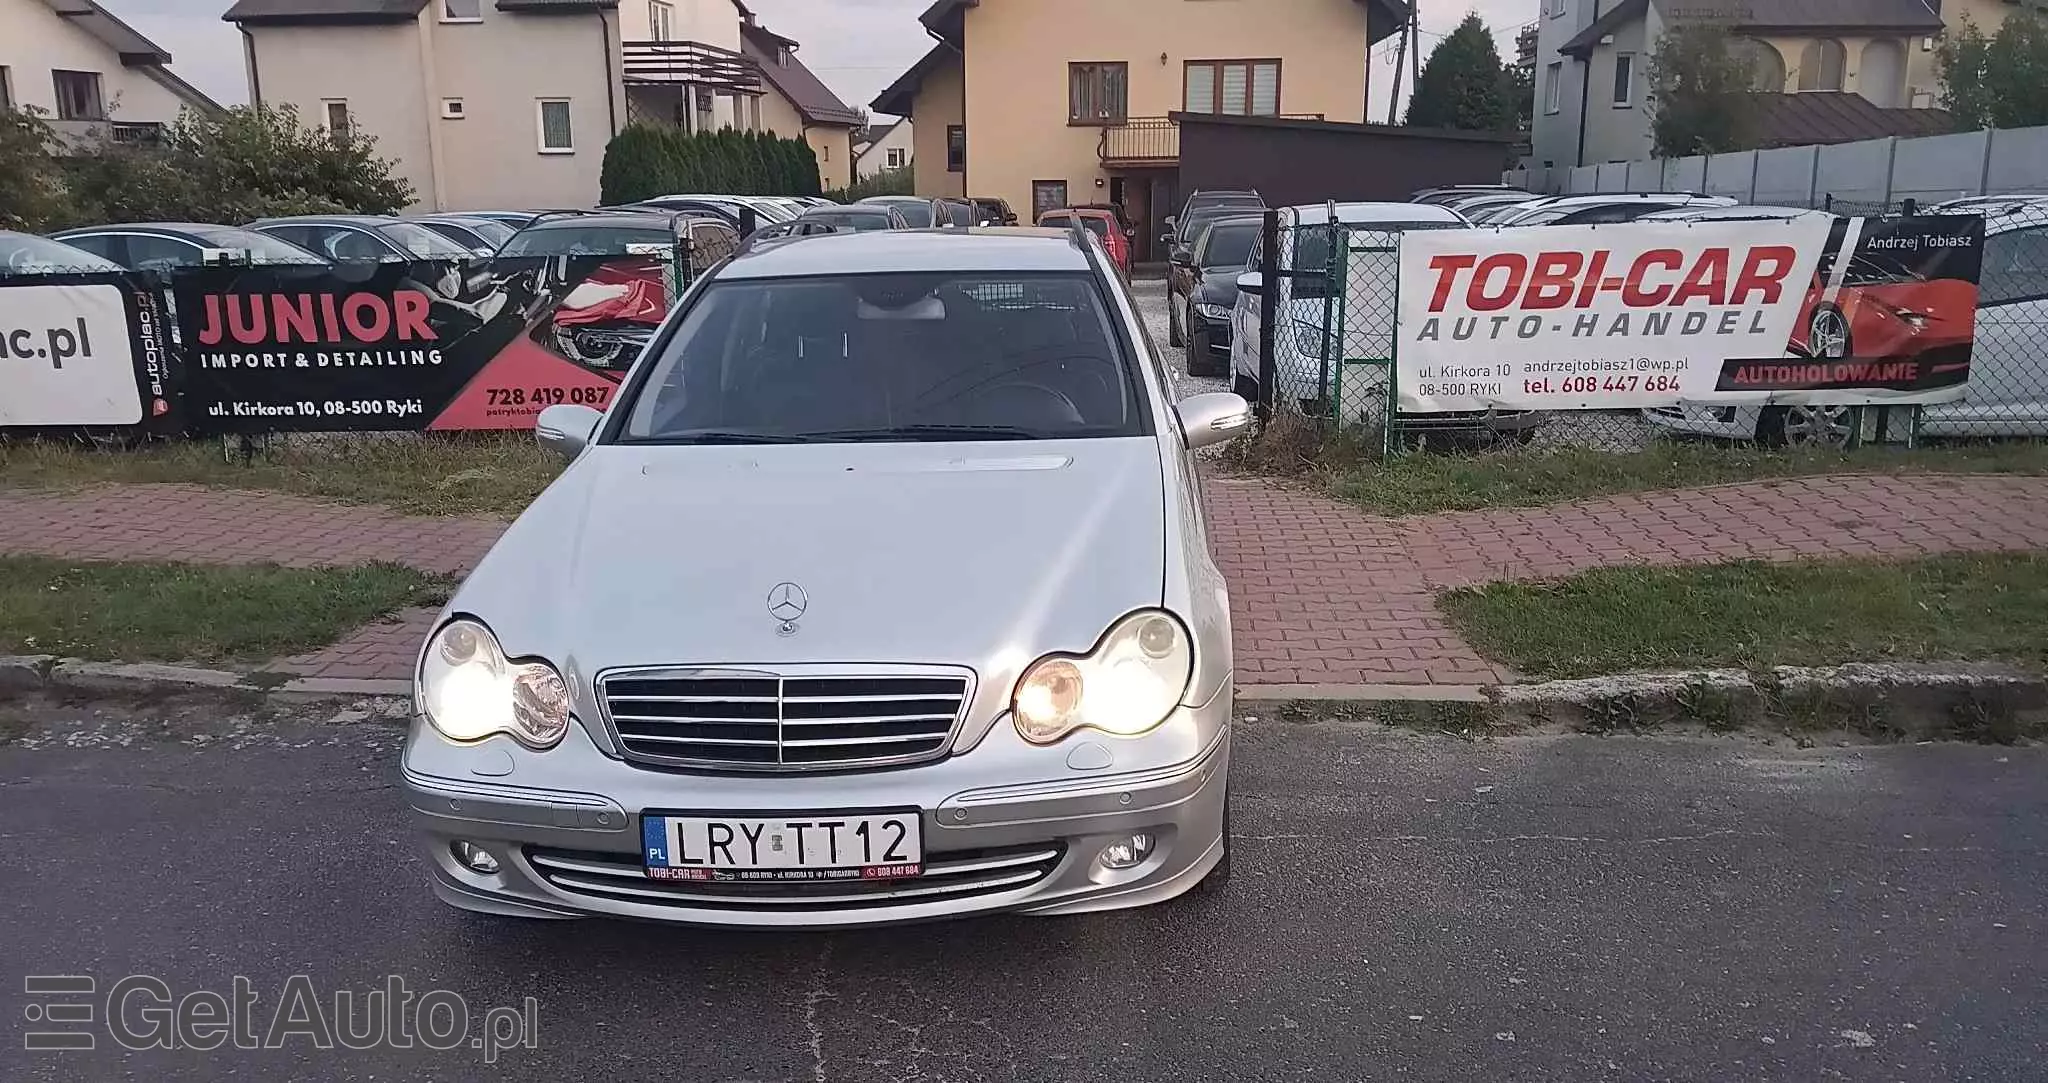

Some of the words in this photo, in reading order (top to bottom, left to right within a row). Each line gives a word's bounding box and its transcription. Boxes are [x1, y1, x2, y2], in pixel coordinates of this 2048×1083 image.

[1867, 235, 1918, 250] Andrzej
[1922, 234, 1972, 247] Tobiasz
[1428, 245, 1797, 312] TOBI-CAR
[199, 290, 440, 345] JUNIOR
[1416, 310, 1767, 341] AUTO-HANDEL
[134, 291, 163, 396] autoplac.pl
[200, 353, 287, 368] IMPORT
[295, 353, 310, 367] &
[317, 350, 443, 366] DETAILING
[1523, 357, 1689, 374] andrzejtobiasz1@wp.pl
[1419, 364, 1436, 378] ul.
[1441, 364, 1490, 378] Kirkora
[1497, 364, 1511, 377] 10
[1734, 363, 1919, 384] AUTOHOLOWANIE
[1419, 383, 1465, 396] 08-500
[1471, 383, 1501, 395] RYKI
[1523, 377, 1555, 394] tel.
[1562, 376, 1597, 393] 608
[1602, 375, 1638, 392] 447
[1645, 375, 1680, 392] 684
[486, 388, 525, 406] 728
[531, 387, 564, 404] 419
[571, 386, 609, 403] 087
[209, 401, 229, 416] ul.
[234, 401, 294, 416] Kirkora
[297, 401, 320, 418] 10,
[324, 400, 383, 415] 08-500
[387, 399, 423, 417] Ryki
[677, 822, 765, 865] LRY
[786, 820, 908, 865] TT12
[649, 850, 665, 860] PL
[649, 867, 690, 879] TOBI-CAR
